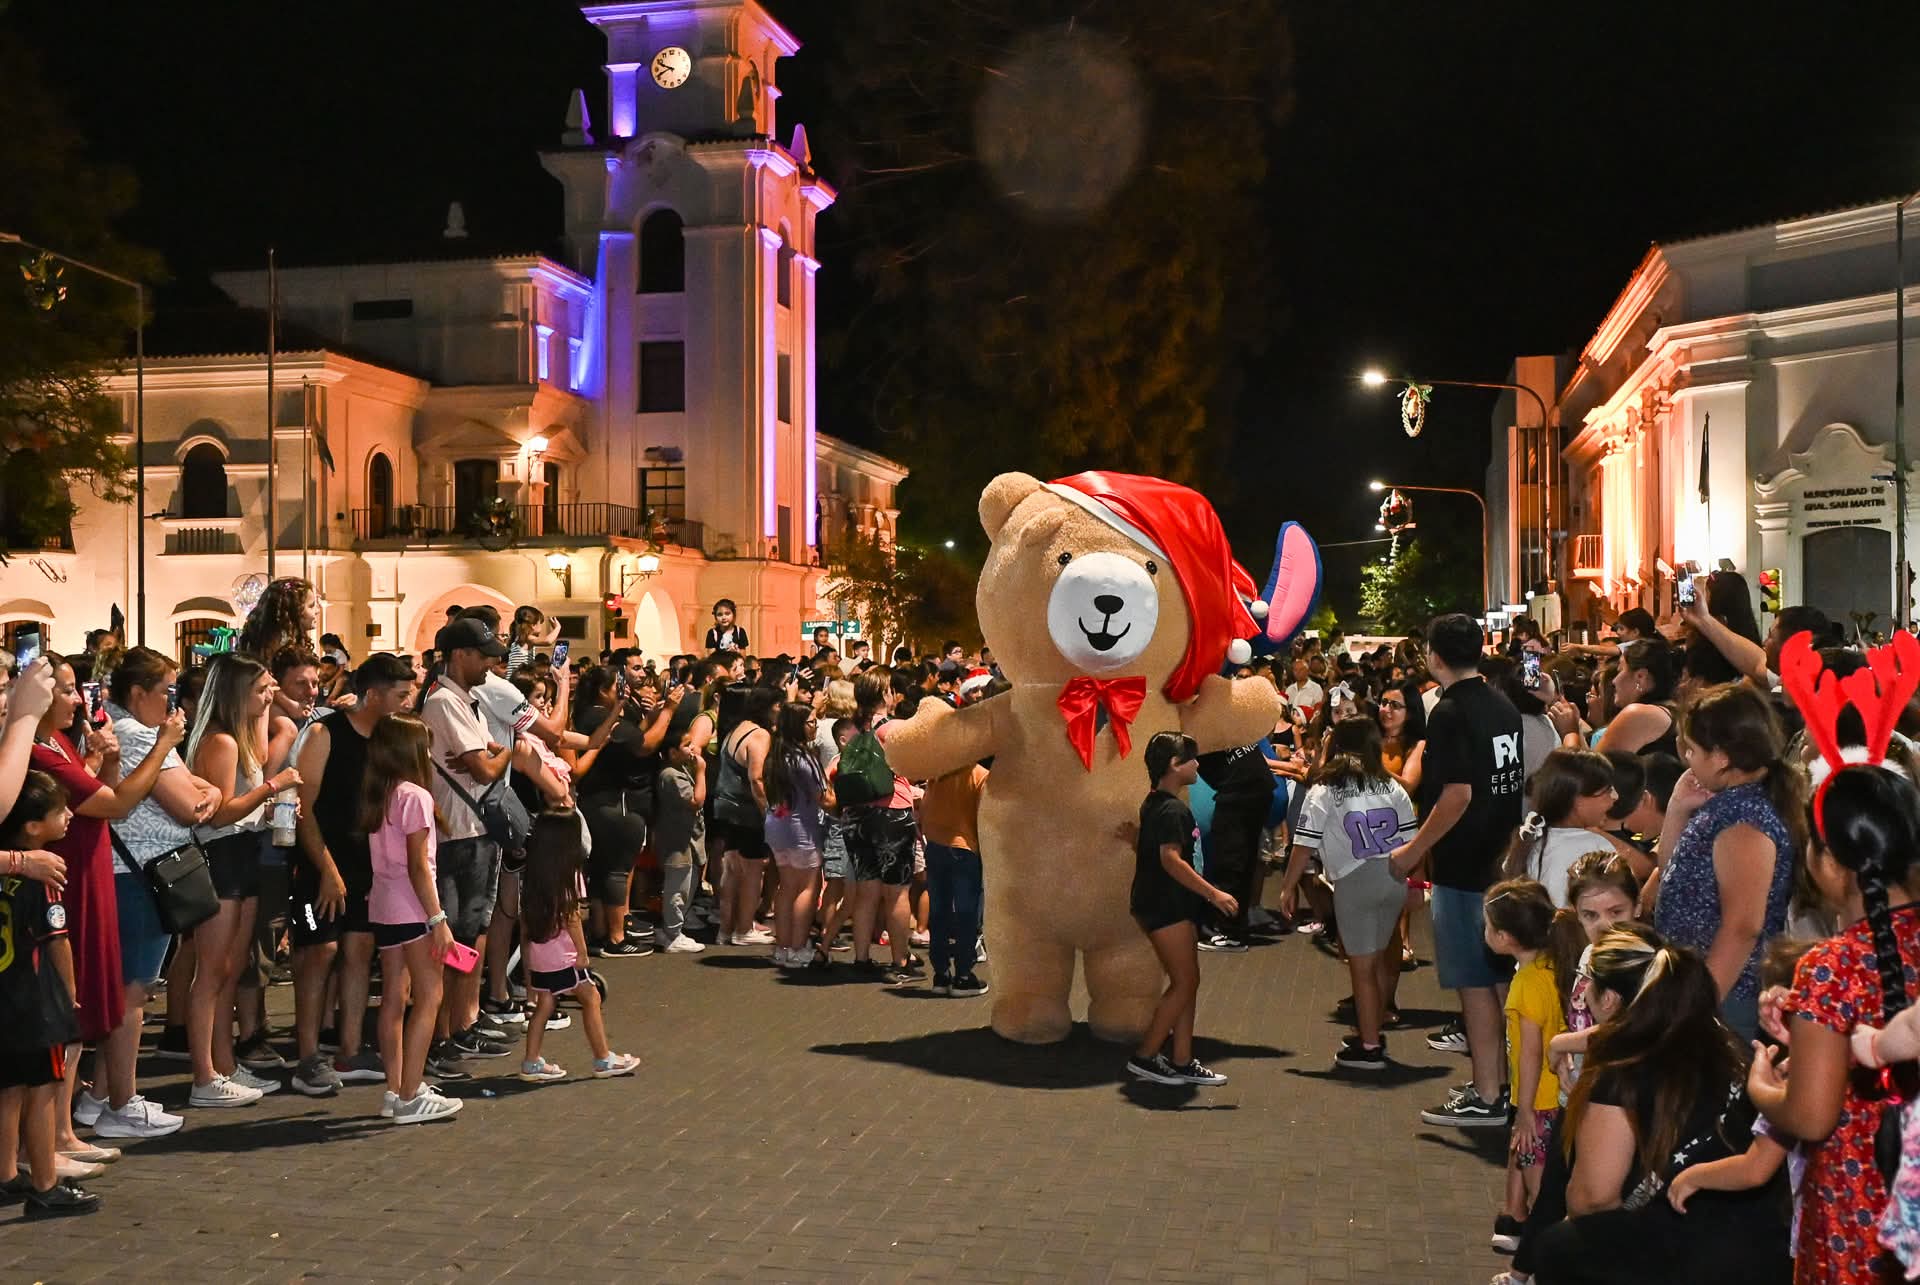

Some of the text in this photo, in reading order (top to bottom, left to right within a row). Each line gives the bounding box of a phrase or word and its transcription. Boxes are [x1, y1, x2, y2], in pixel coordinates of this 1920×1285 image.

[1829, 501, 1849, 509] SAN
[1492, 731, 1520, 769] FX
[1343, 807, 1404, 860] 02
